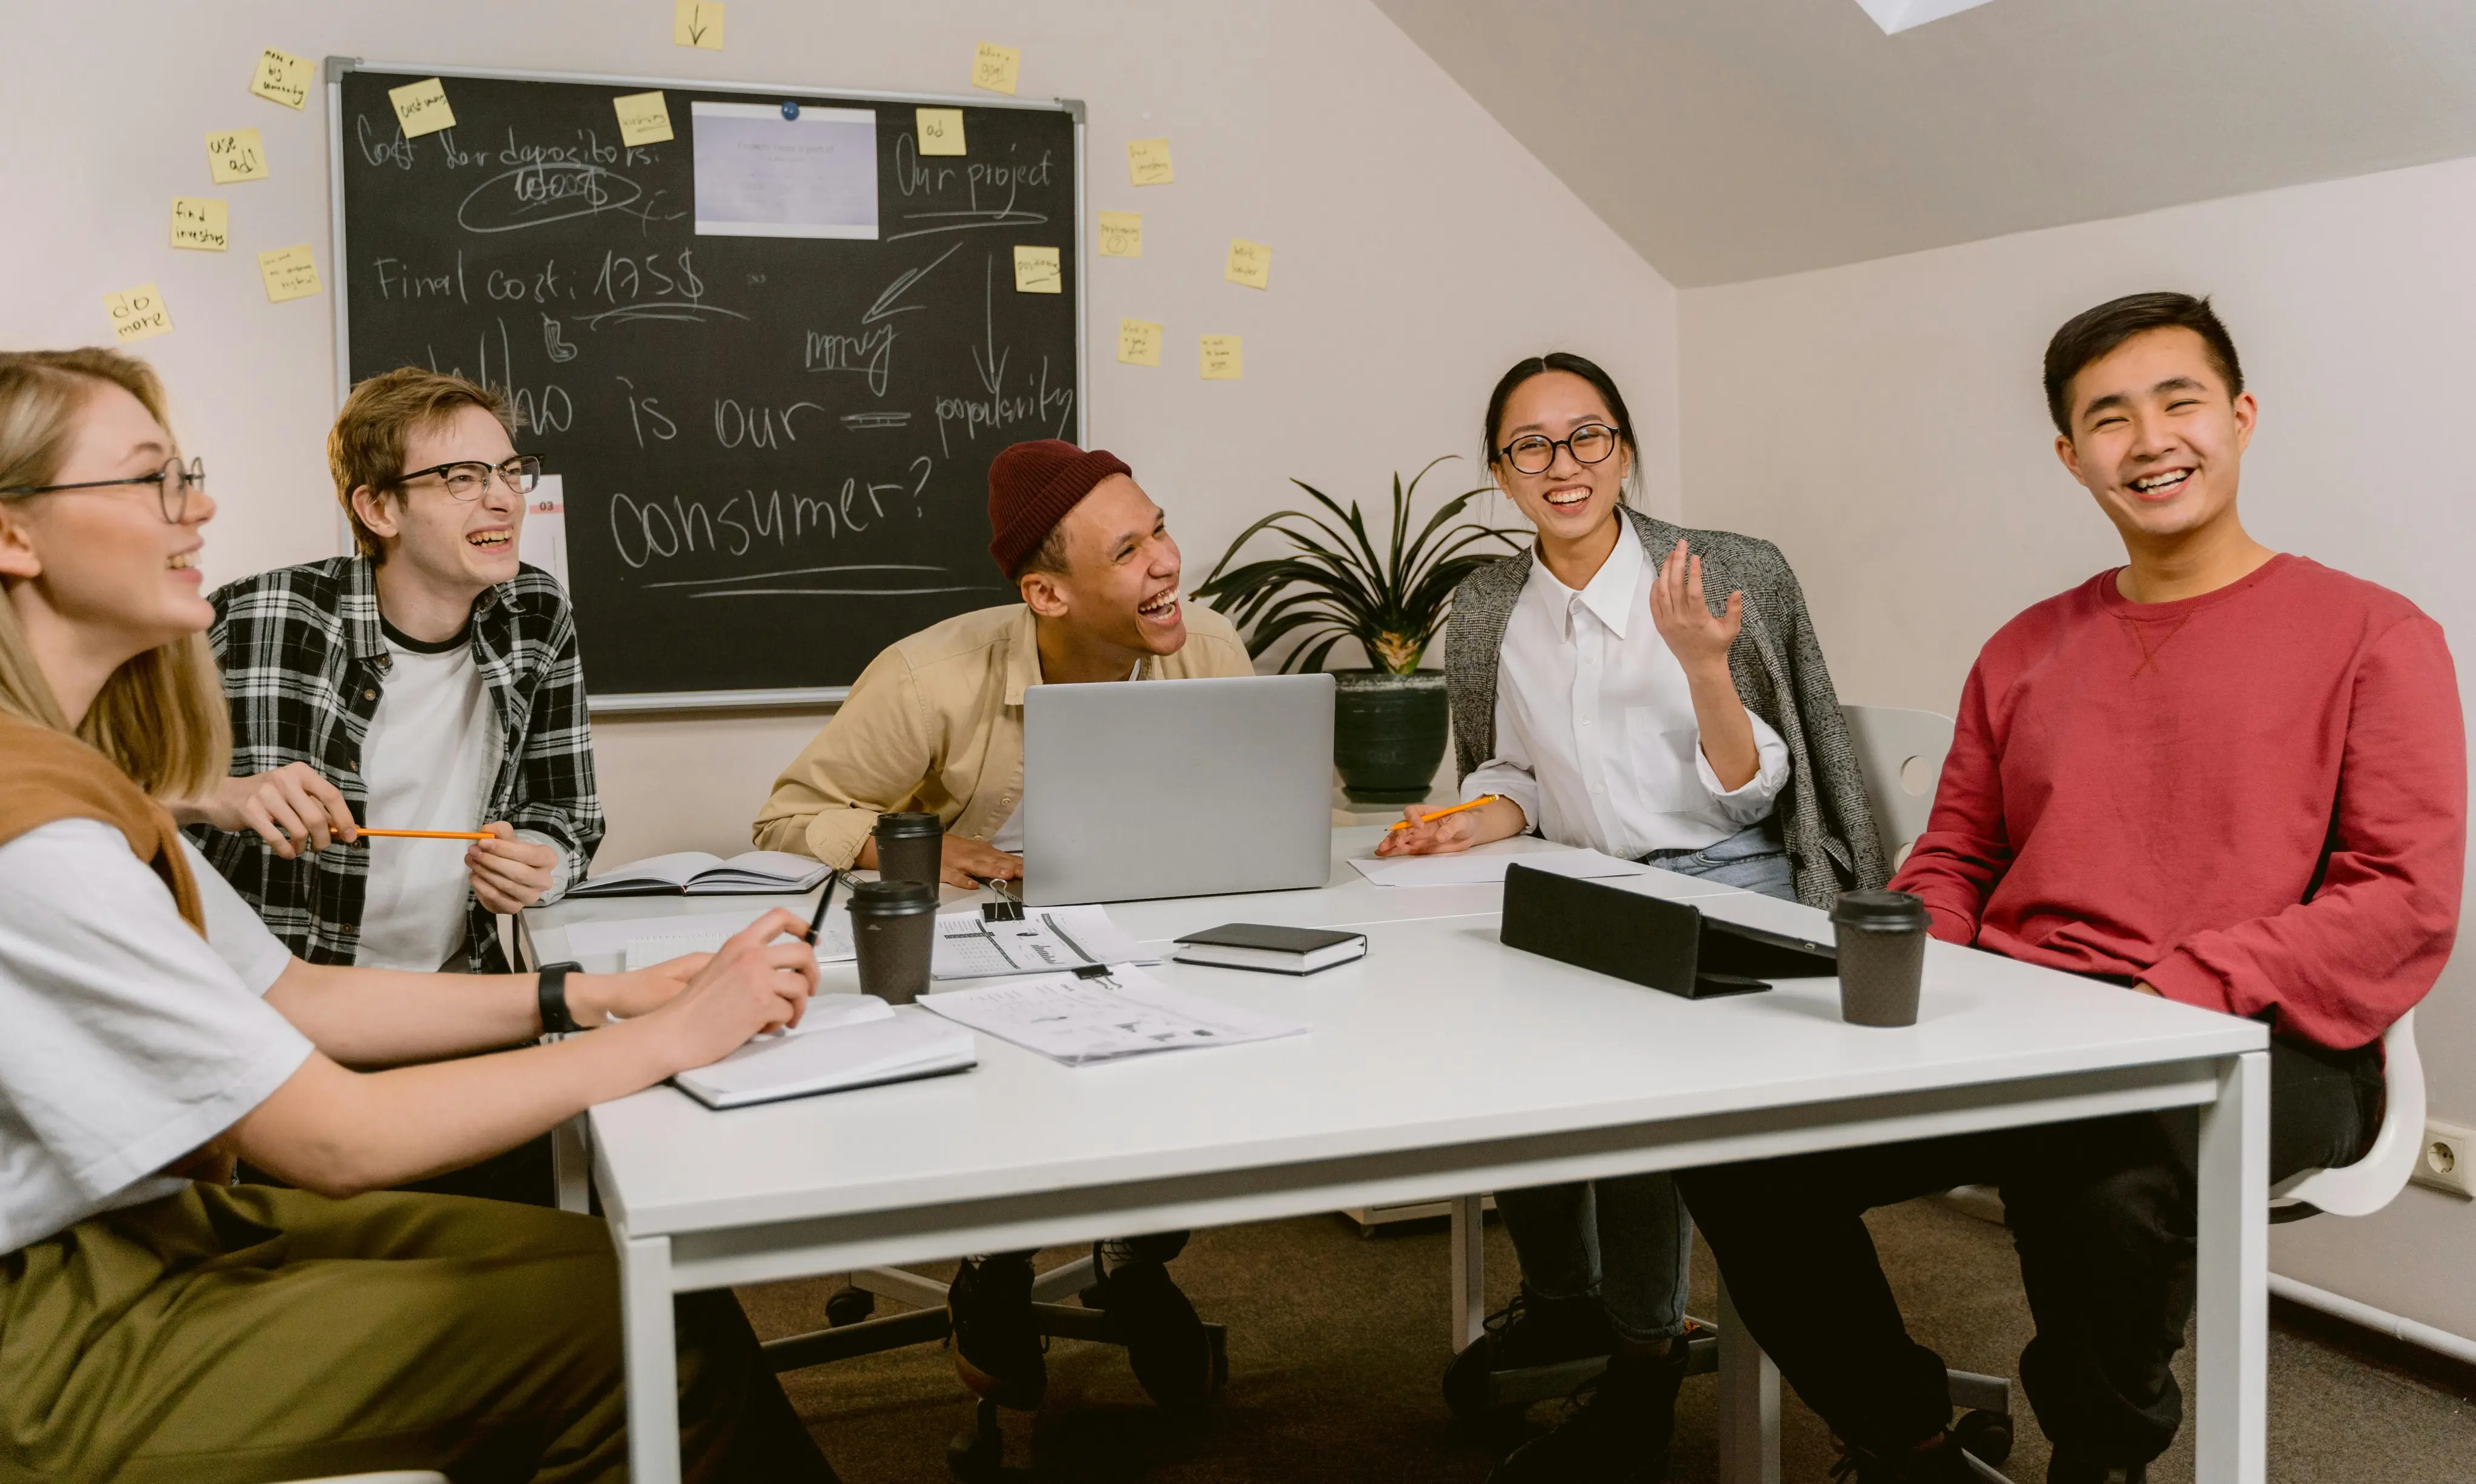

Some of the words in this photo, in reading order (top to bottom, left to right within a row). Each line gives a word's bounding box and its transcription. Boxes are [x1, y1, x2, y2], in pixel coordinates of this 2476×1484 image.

[210, 136, 237, 154] use
[895, 132, 956, 196] Our
[968, 143, 1053, 220] project
[175, 200, 205, 223] find
[373, 249, 468, 305] Final
[113, 293, 150, 319] do
[118, 311, 165, 337] more
[615, 376, 677, 449] is
[714, 398, 826, 450] our
[539, 501, 554, 511] 03
